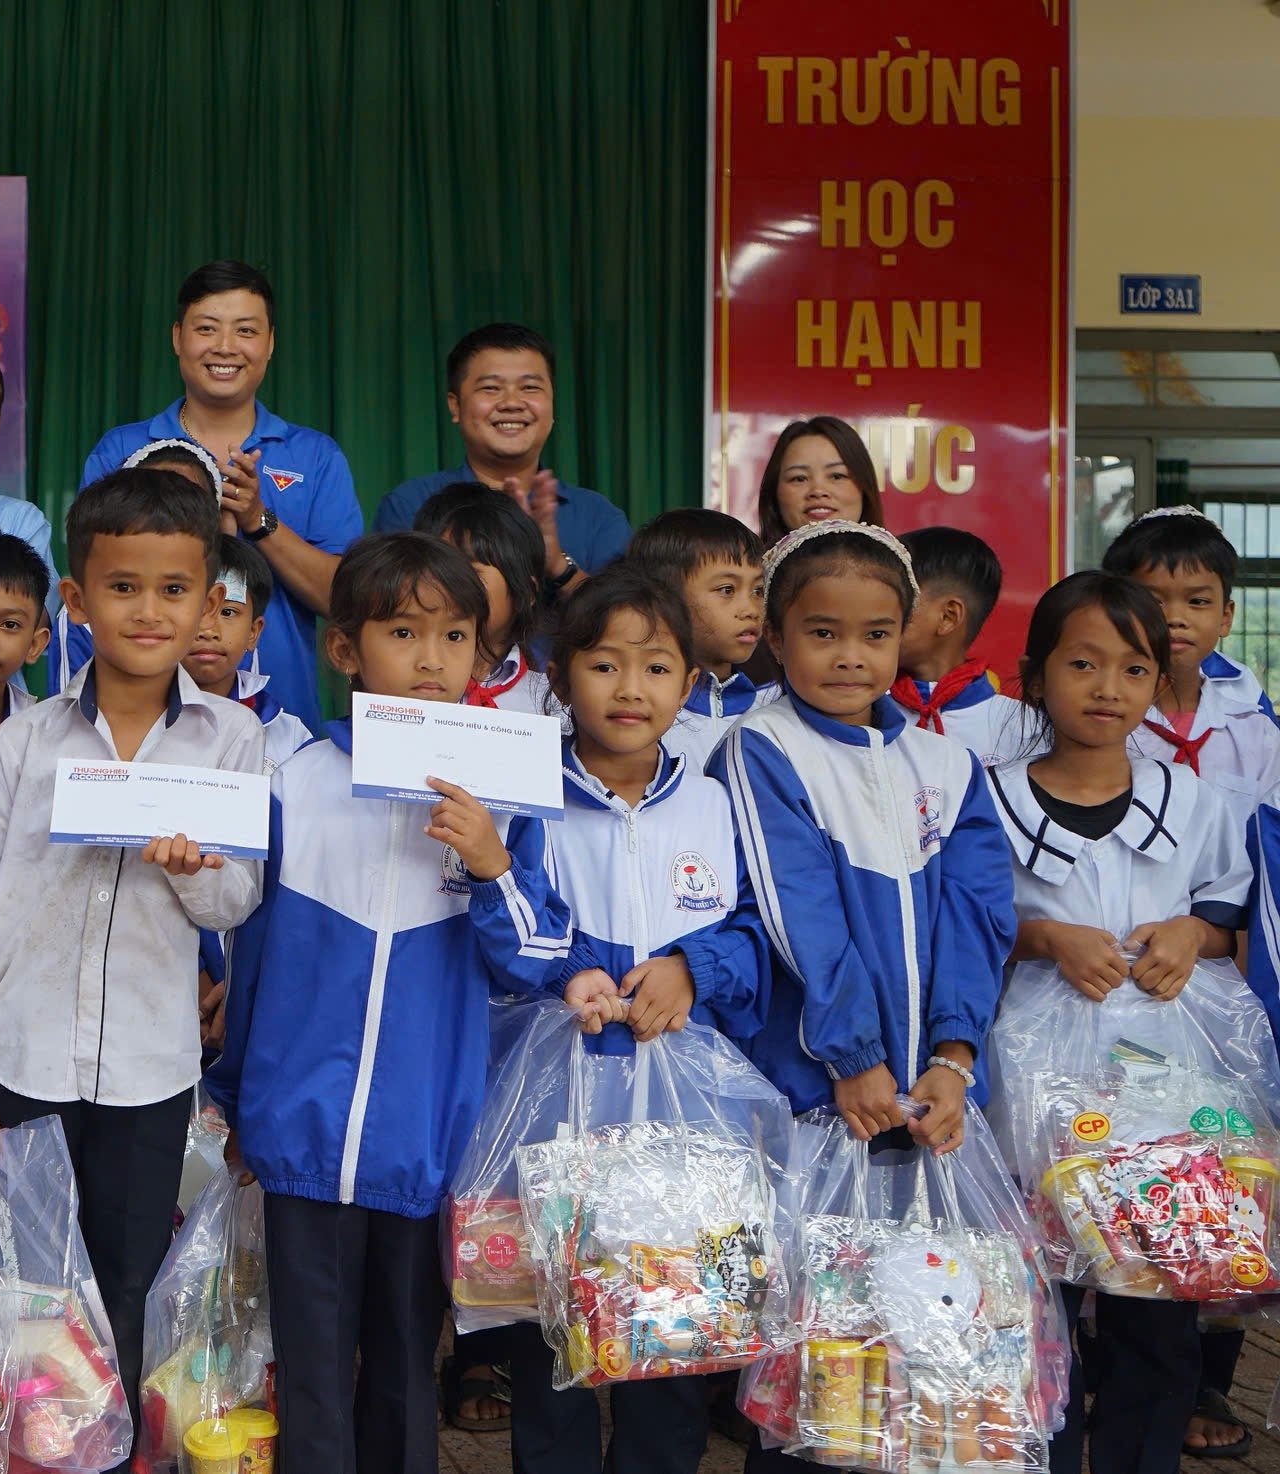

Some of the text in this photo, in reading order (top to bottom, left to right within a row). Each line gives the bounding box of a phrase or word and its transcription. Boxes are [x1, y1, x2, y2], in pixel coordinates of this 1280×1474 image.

[759, 36, 1021, 127] TRƯỜNG
[820, 179, 955, 266] HỌC
[1127, 281, 1195, 309] LỚP 3A1
[796, 300, 982, 386] HẠNH
[855, 403, 976, 495] HÚC
[490, 725, 513, 734] CÔNG
[1077, 1118, 1105, 1135] CP
